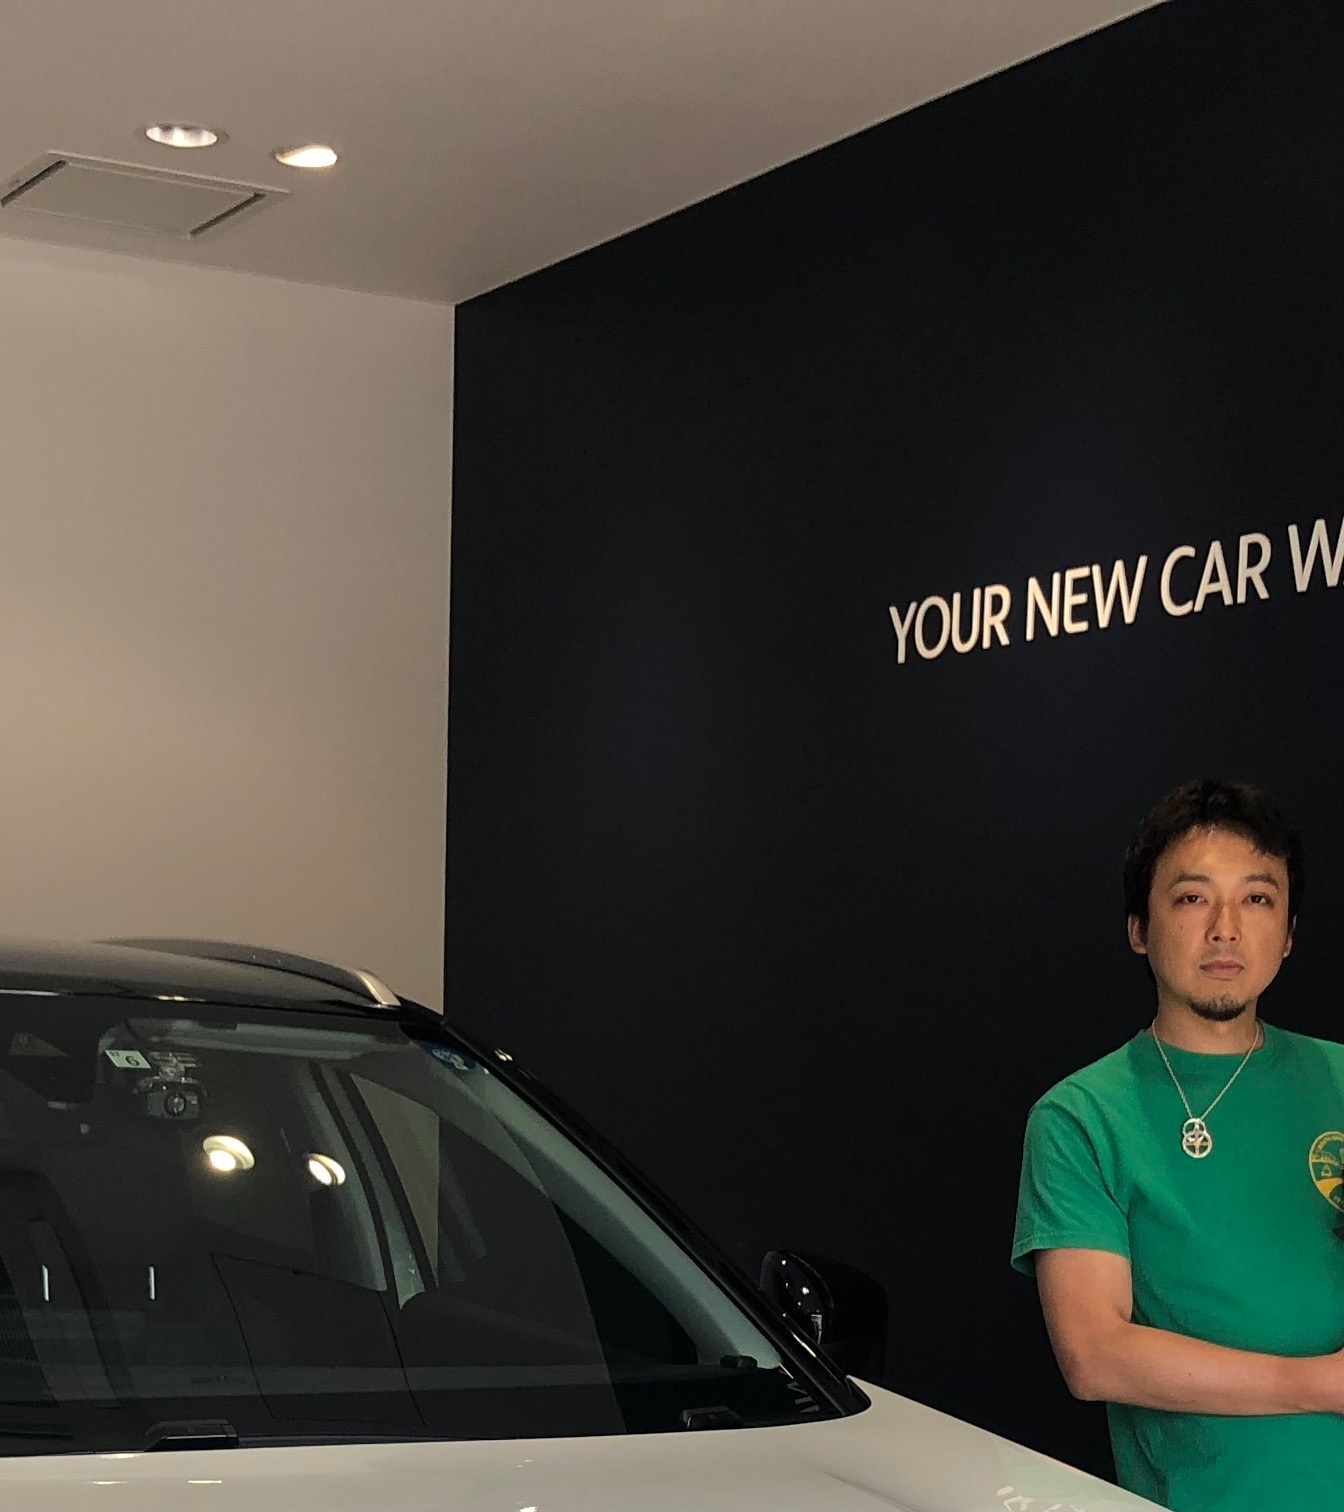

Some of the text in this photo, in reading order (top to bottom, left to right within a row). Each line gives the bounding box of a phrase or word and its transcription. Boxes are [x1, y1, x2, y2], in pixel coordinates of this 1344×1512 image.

[888, 583, 1012, 664] YOUR
[1025, 554, 1149, 642] NEW
[1160, 532, 1272, 617] CAR
